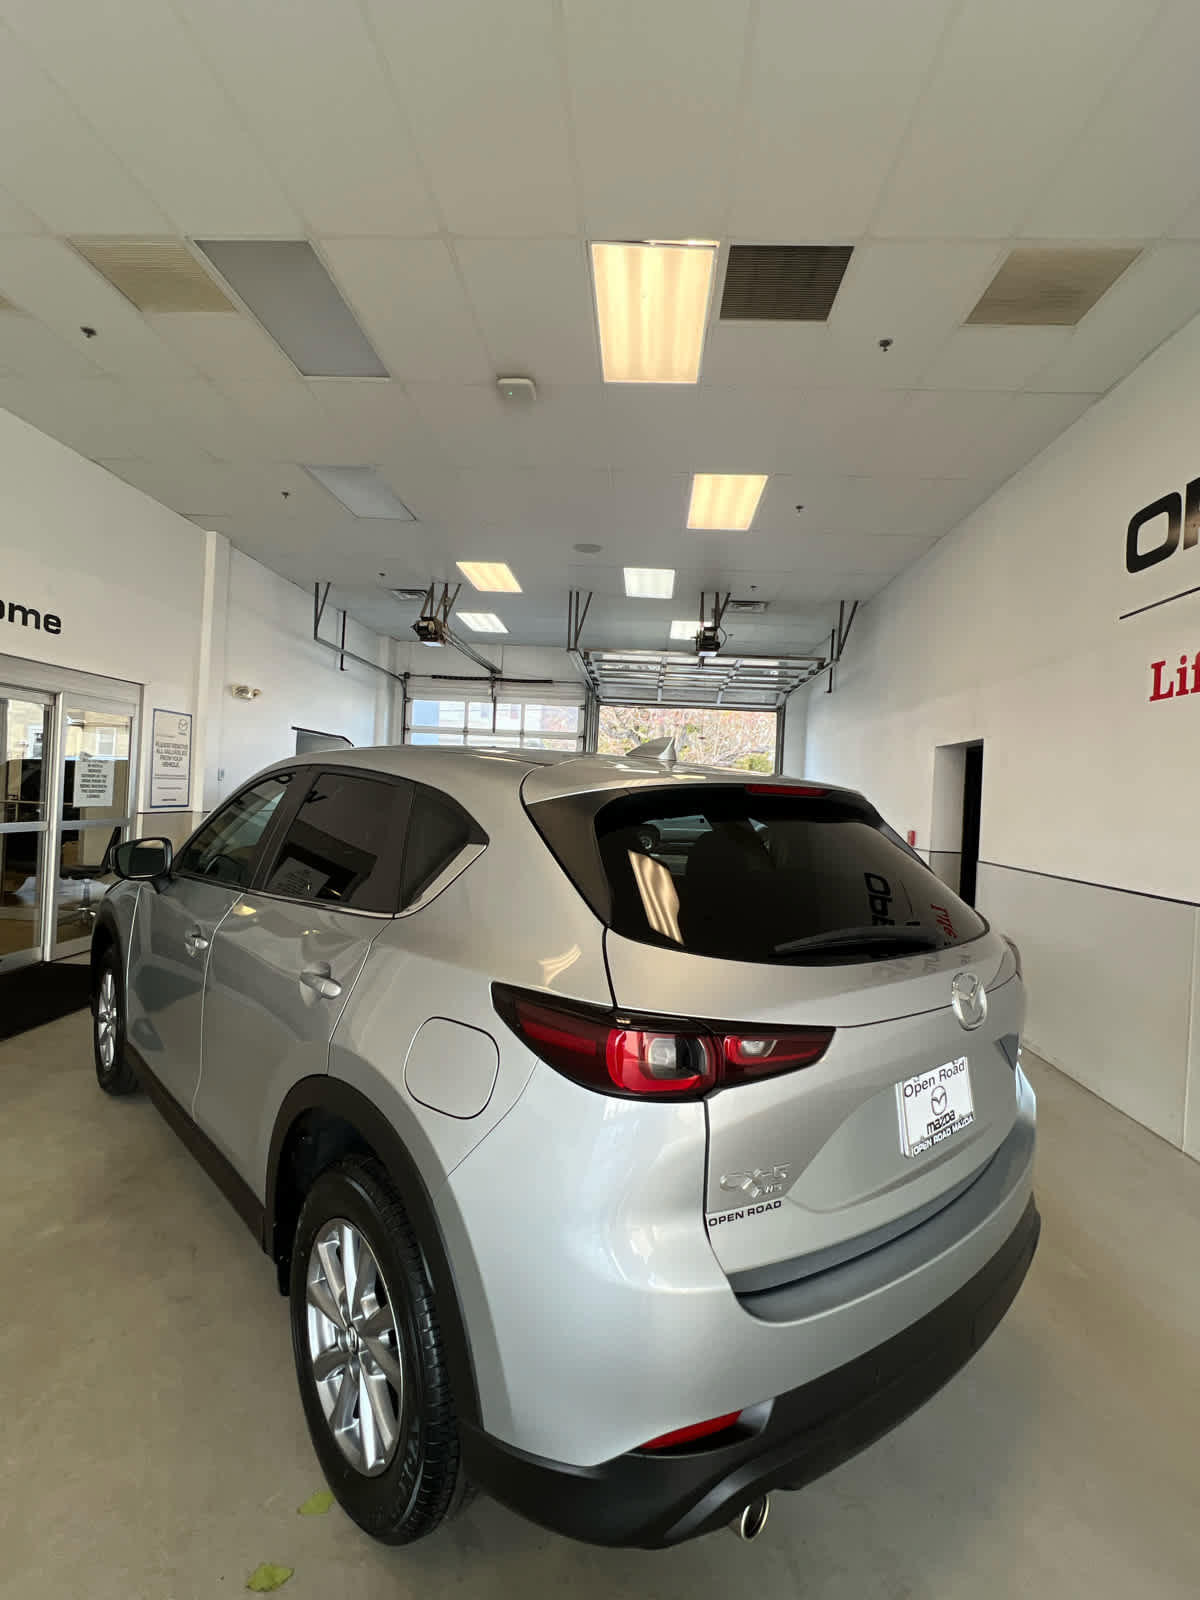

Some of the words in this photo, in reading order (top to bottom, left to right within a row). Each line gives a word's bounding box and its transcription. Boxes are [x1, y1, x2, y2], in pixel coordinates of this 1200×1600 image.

[0, 600, 61, 634] me
[904, 1076, 936, 1098] Open
[938, 1060, 965, 1082] Road
[912, 1138, 933, 1156] OPEN
[933, 1126, 952, 1144] ROAD
[708, 1210, 745, 1227] OPEN
[747, 1200, 782, 1217] ROAD
